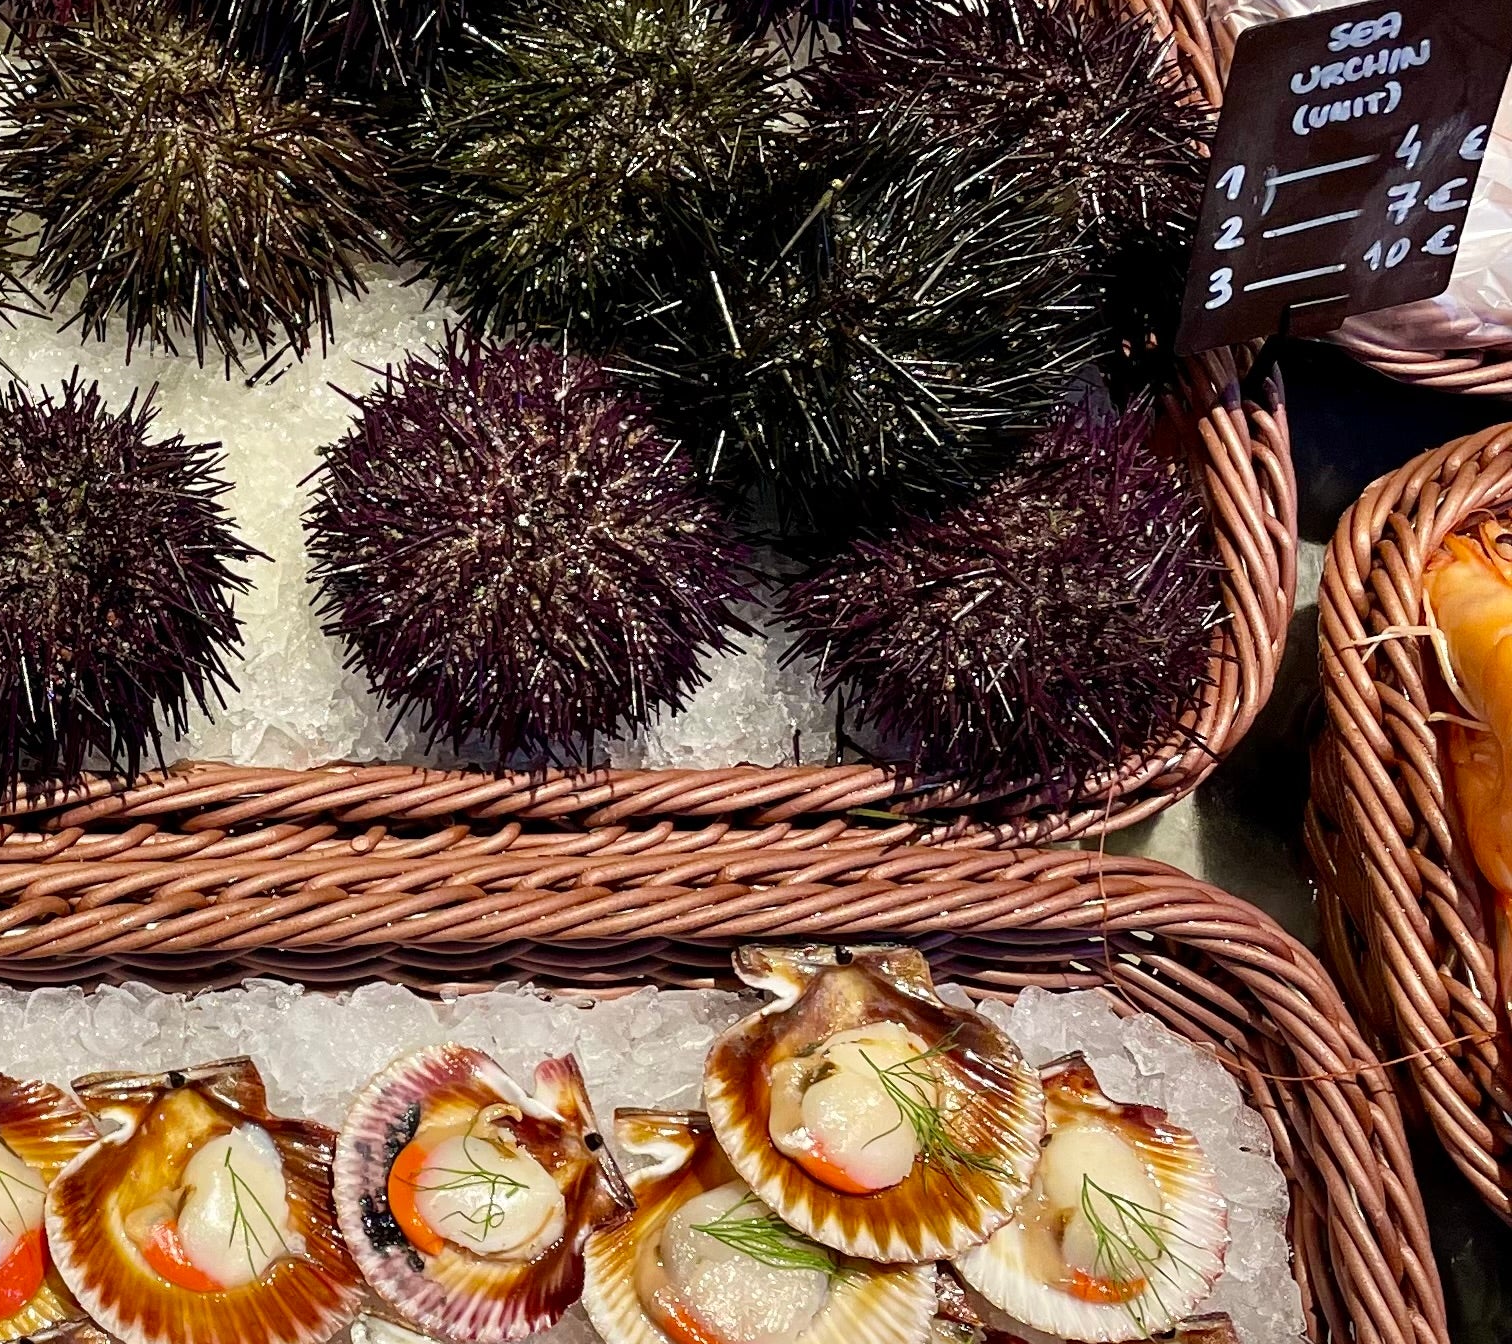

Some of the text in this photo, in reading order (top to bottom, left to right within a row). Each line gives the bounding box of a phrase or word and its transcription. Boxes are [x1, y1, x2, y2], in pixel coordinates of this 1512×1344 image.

[1327, 11, 1403, 52] SEA
[1290, 39, 1431, 94] URCHIN
[1292, 81, 1403, 136] (UNIT)
[1215, 165, 1246, 201] 1
[1395, 123, 1422, 169] 4
[1214, 216, 1245, 250] 2
[1205, 268, 1234, 311] 3
